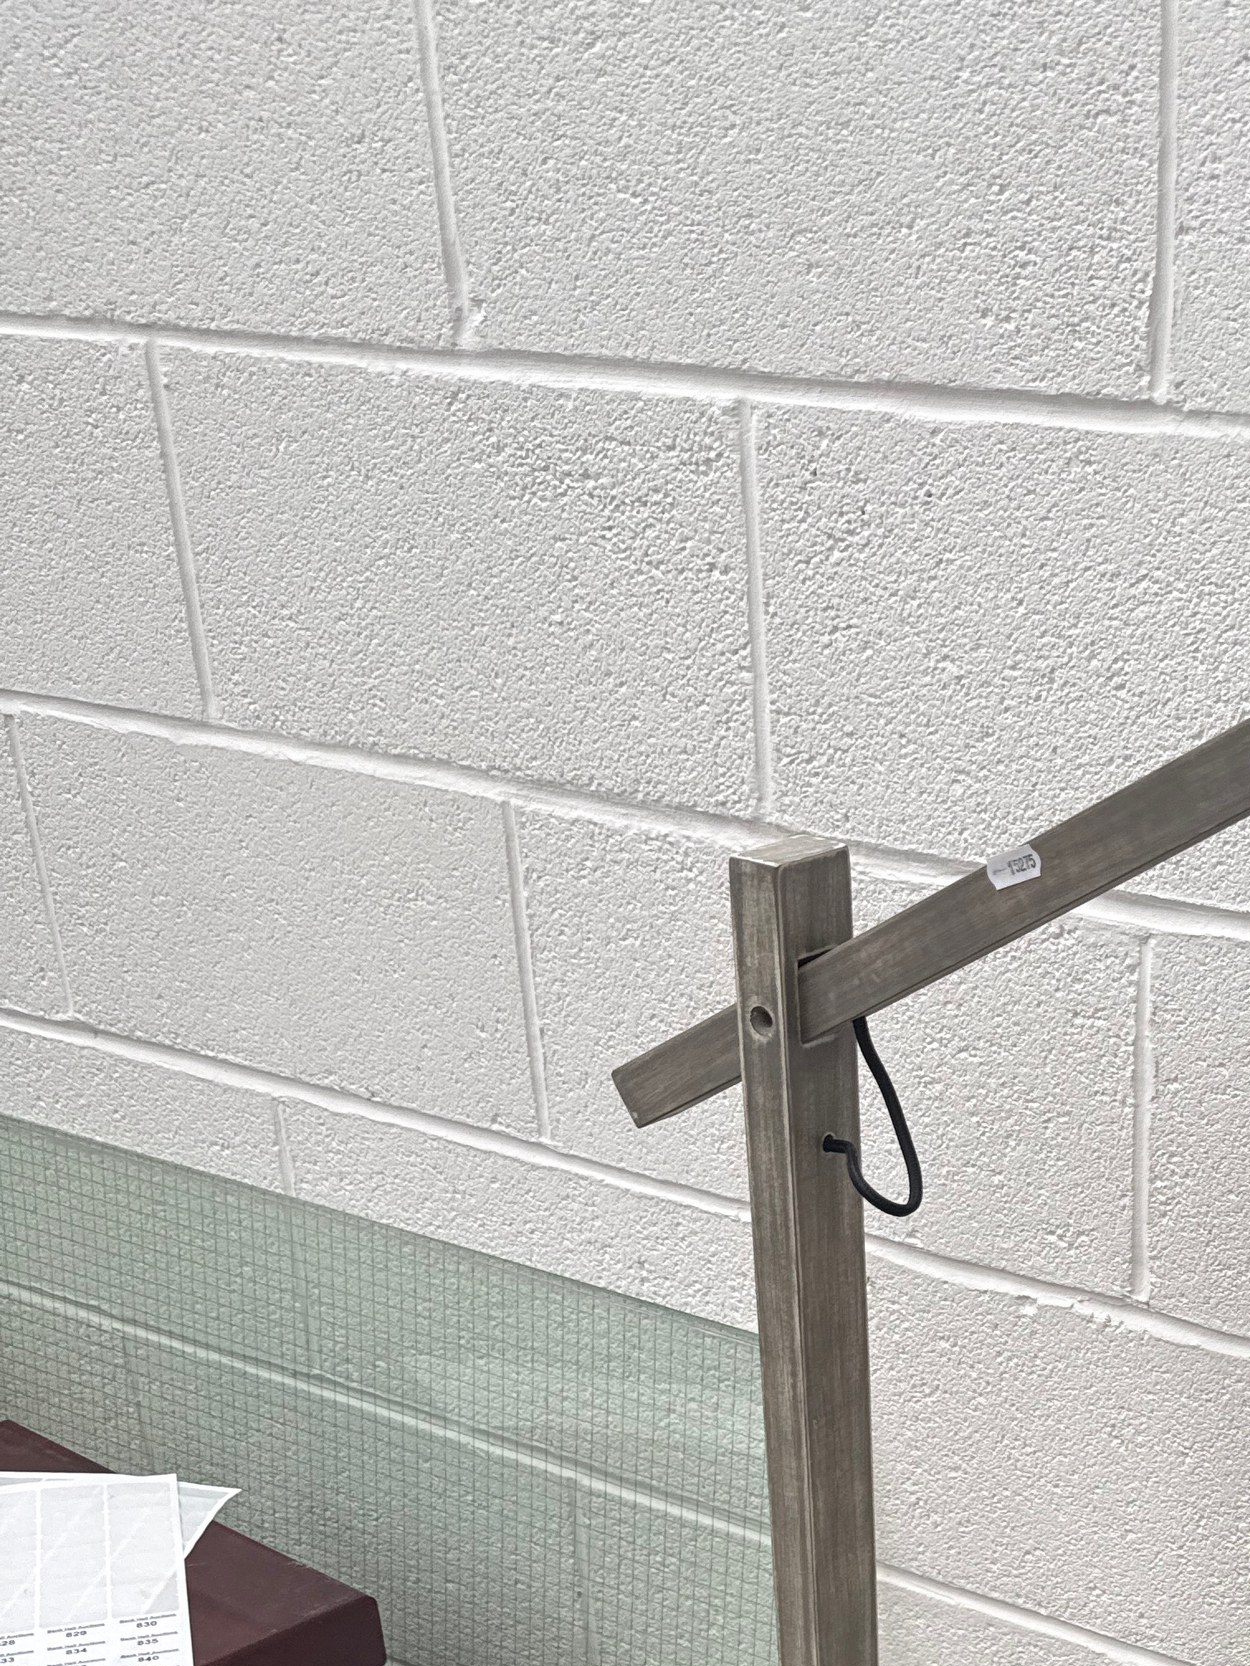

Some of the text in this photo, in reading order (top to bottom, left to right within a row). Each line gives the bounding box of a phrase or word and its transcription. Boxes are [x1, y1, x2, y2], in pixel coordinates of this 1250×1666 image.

[136, 1620, 157, 1628] 830
[65, 1630, 87, 1638] 829
[137, 1638, 159, 1646] 835
[65, 1647, 87, 1655] 834
